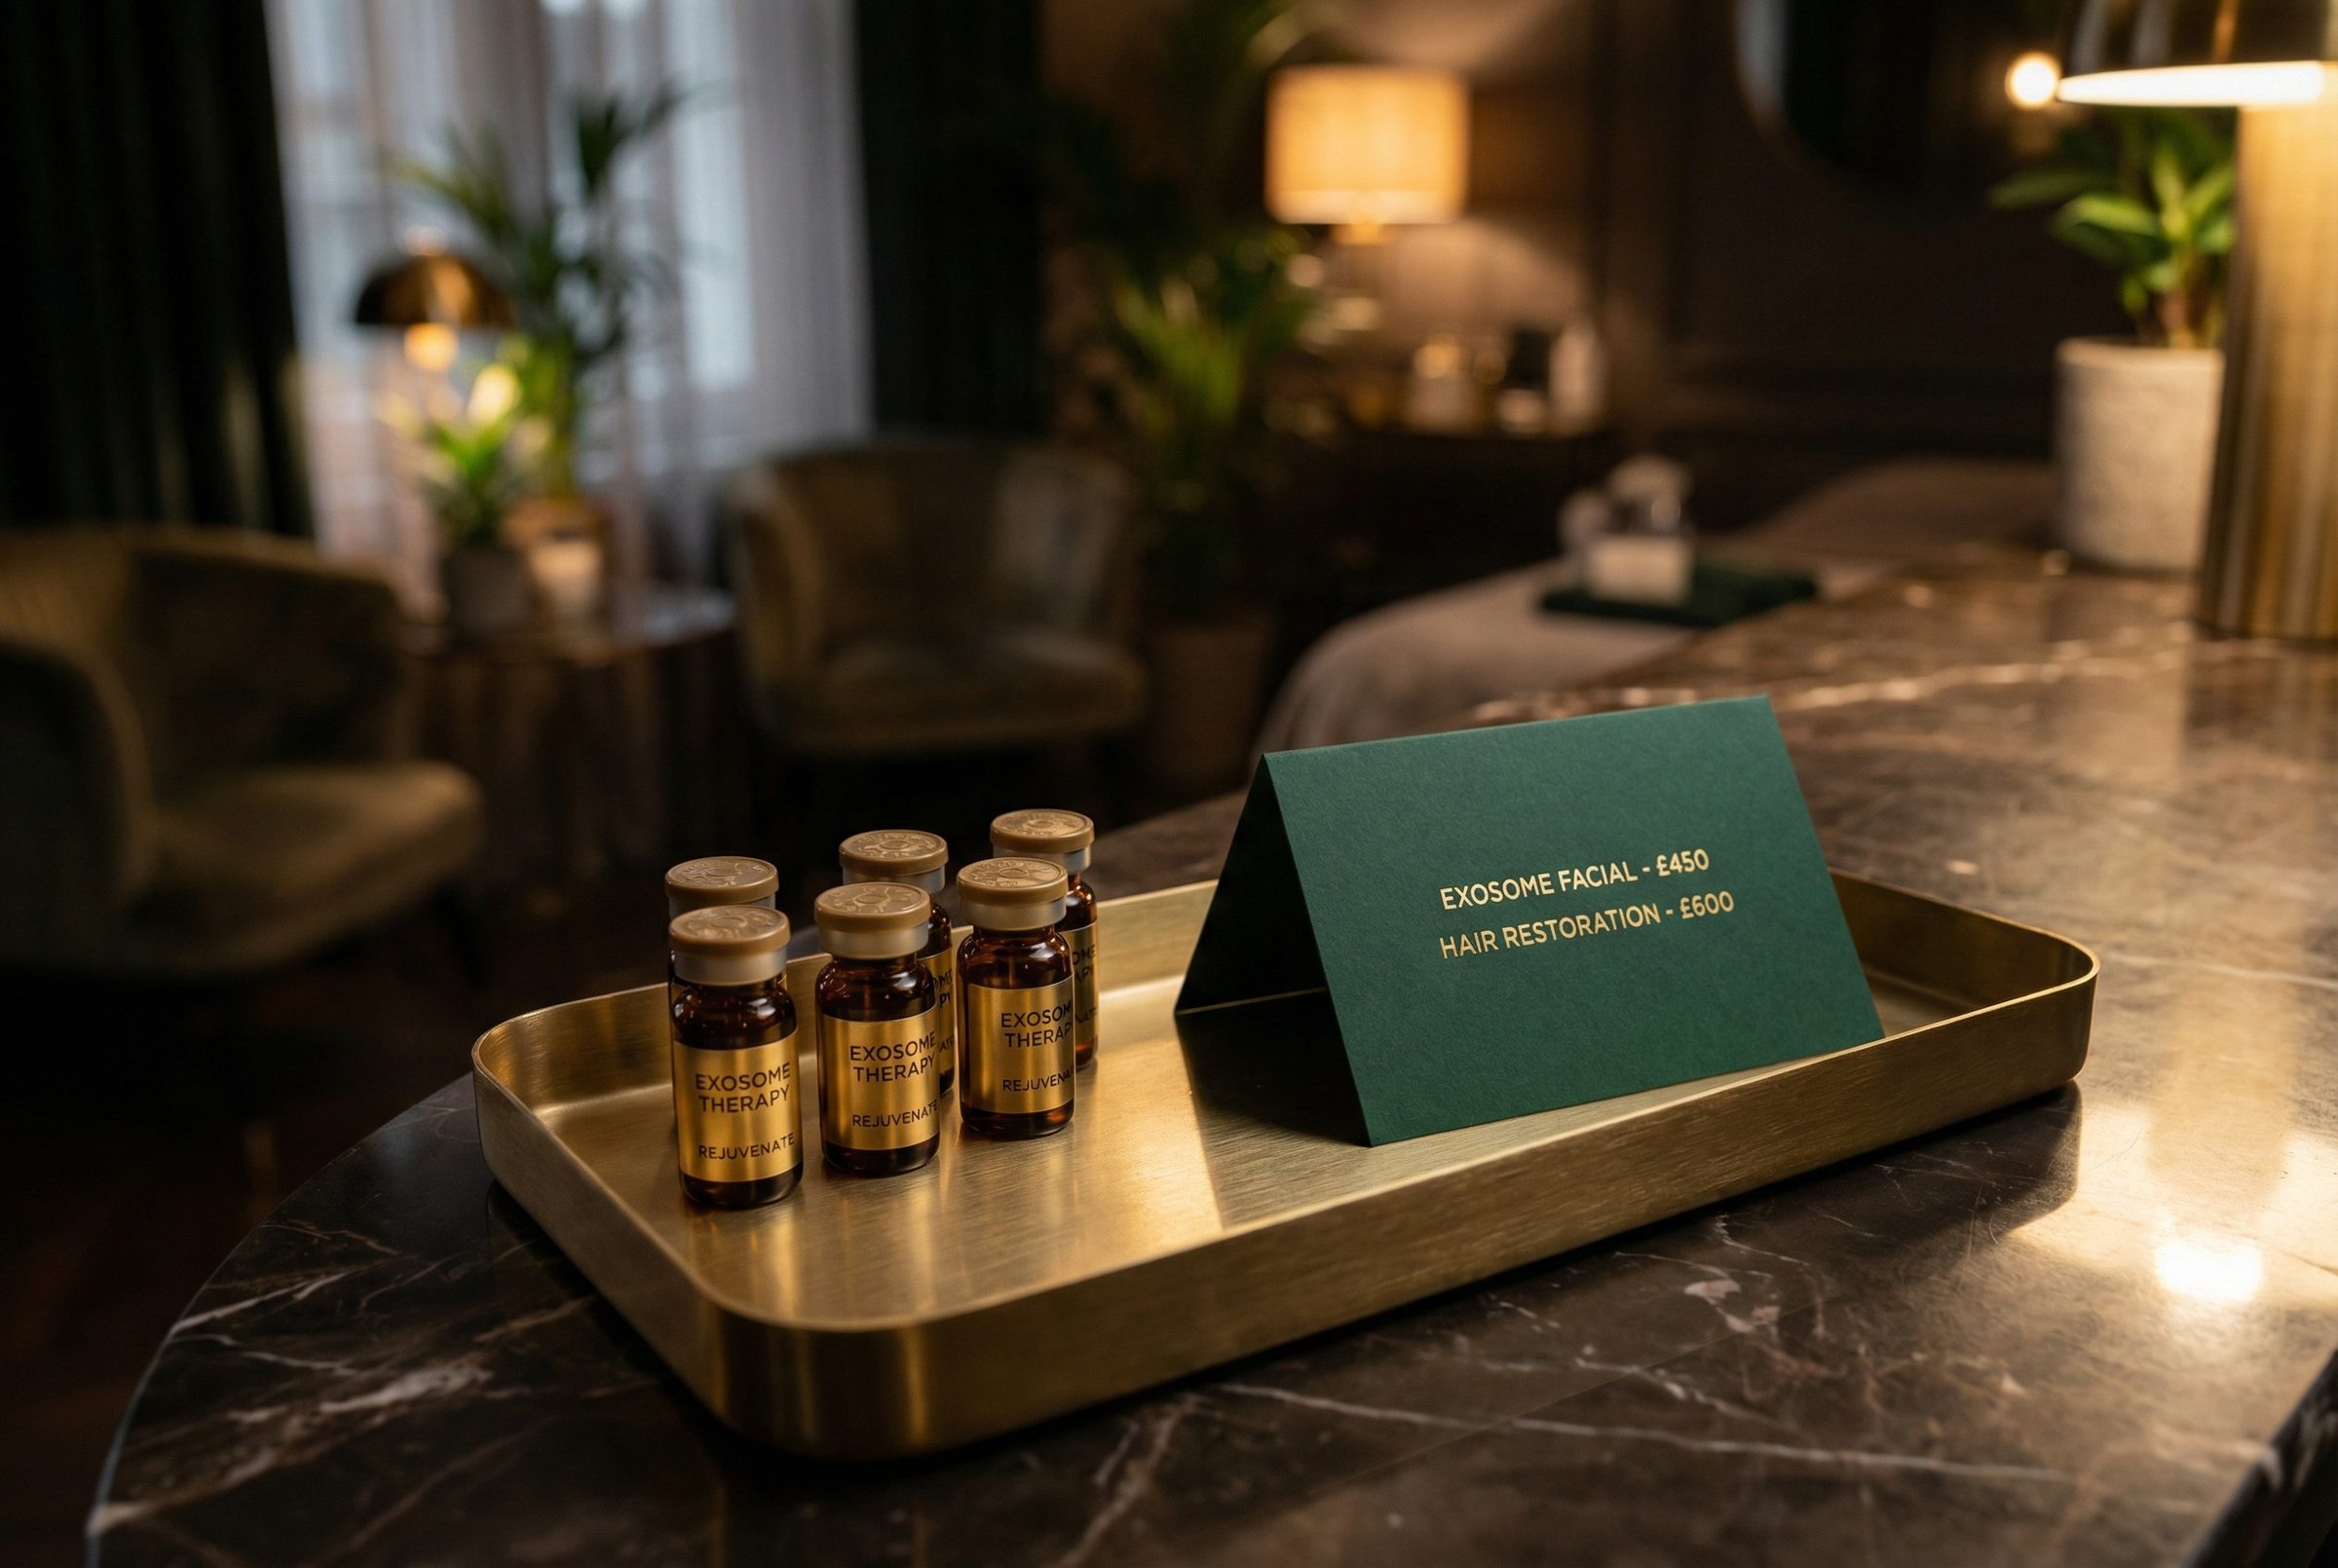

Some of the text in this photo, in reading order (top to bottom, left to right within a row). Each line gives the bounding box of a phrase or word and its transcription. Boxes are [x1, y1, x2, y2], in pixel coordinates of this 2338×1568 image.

[1440, 873, 1555, 910] EXOSOME
[1558, 861, 1638, 891] FACIAL
[1656, 848, 1710, 877] £450
[1439, 930, 1499, 959] HAIR
[1501, 903, 1661, 950] RESTORATION
[1679, 890, 1734, 919] £600
[849, 1030, 936, 1062] EXOSOME
[1004, 1022, 1072, 1048] THERAP
[695, 1062, 791, 1091] EXOSOME
[853, 1053, 935, 1082] THERAPY
[698, 1084, 789, 1113] THERAPY
[852, 1099, 938, 1128] REJUVENATE
[698, 1133, 795, 1160] REJUVENATE
